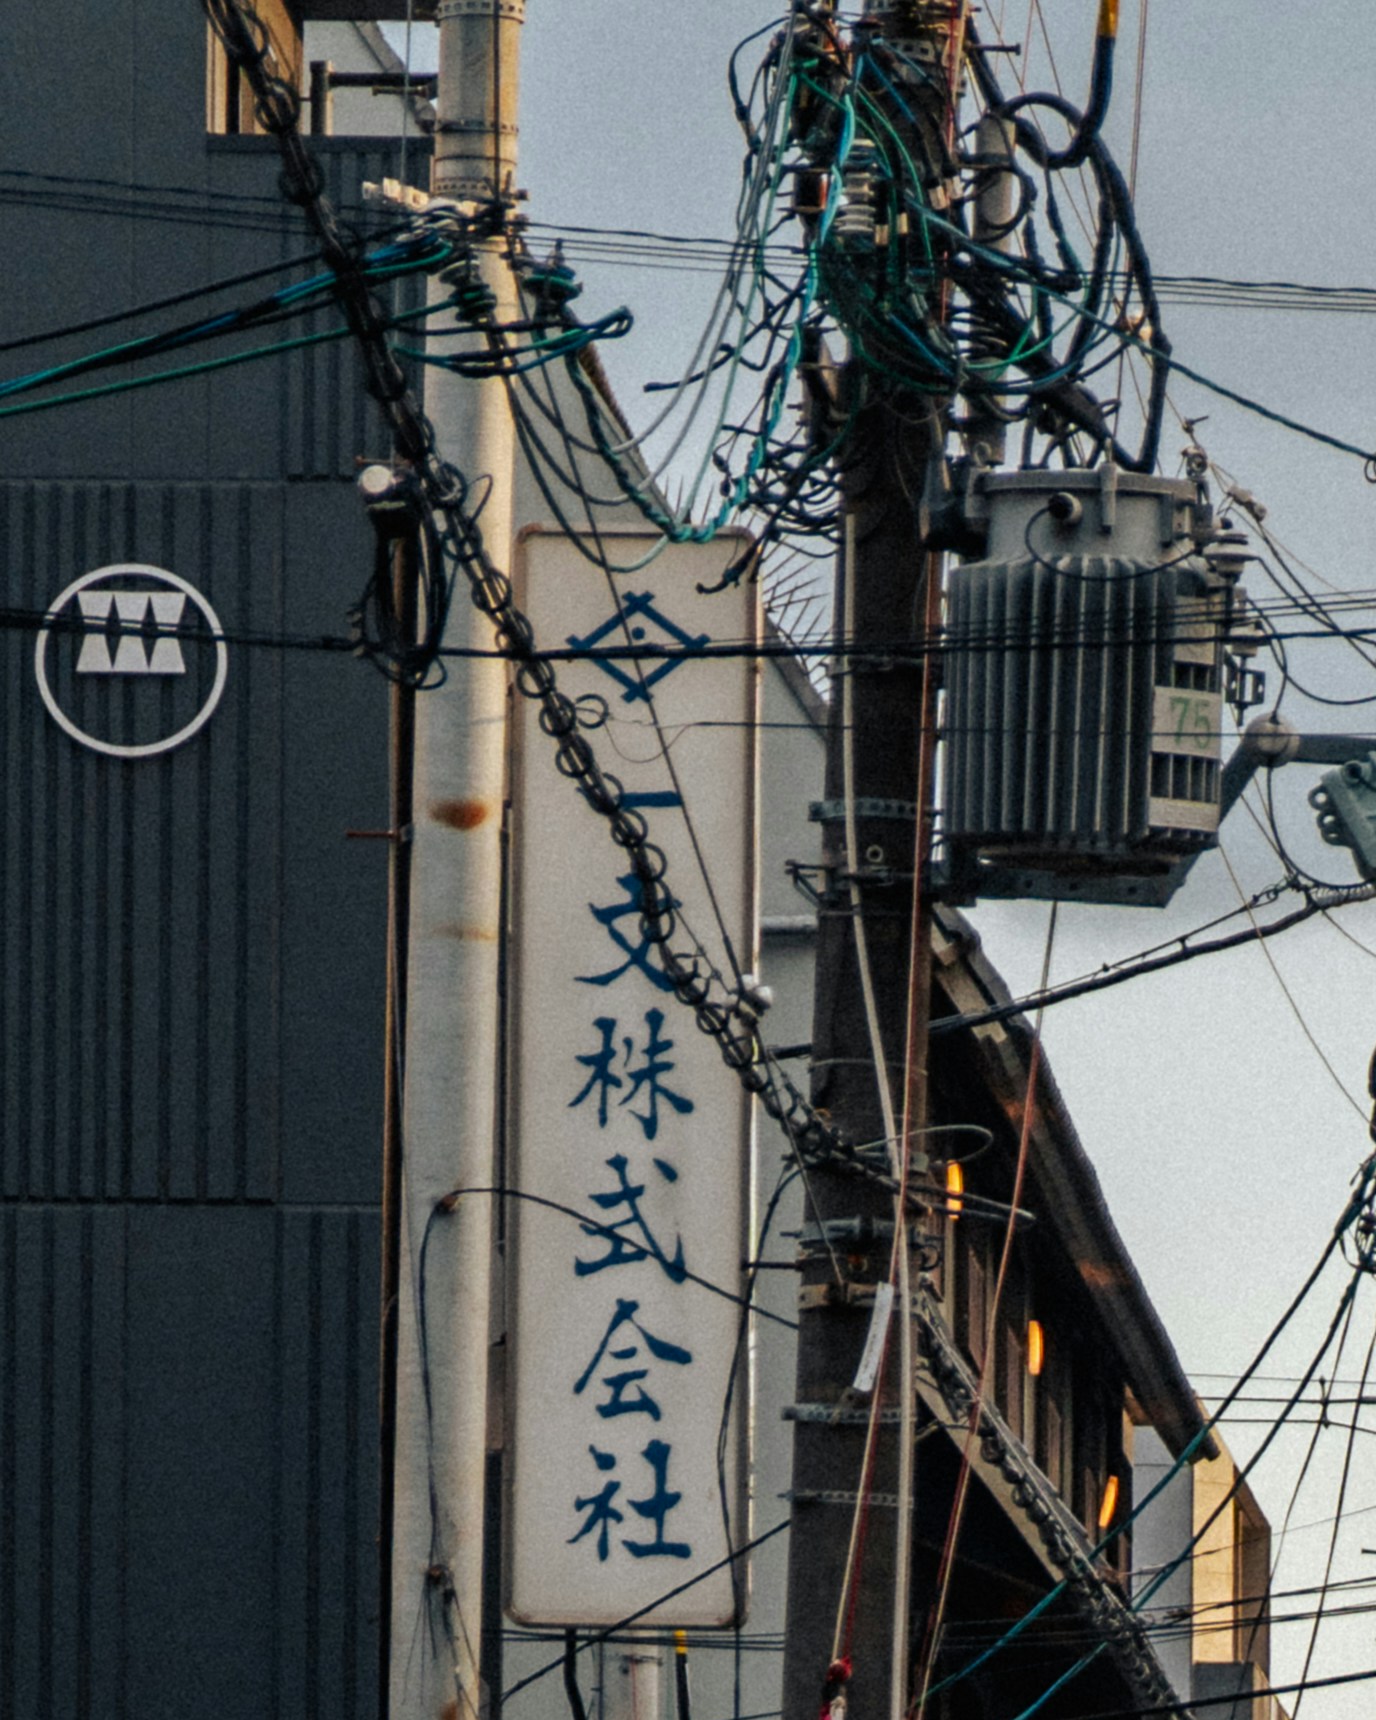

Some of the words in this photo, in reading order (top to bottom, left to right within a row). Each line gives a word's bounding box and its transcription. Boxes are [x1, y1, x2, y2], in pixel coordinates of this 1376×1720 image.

[564, 786, 694, 1563] 一文株式会社
